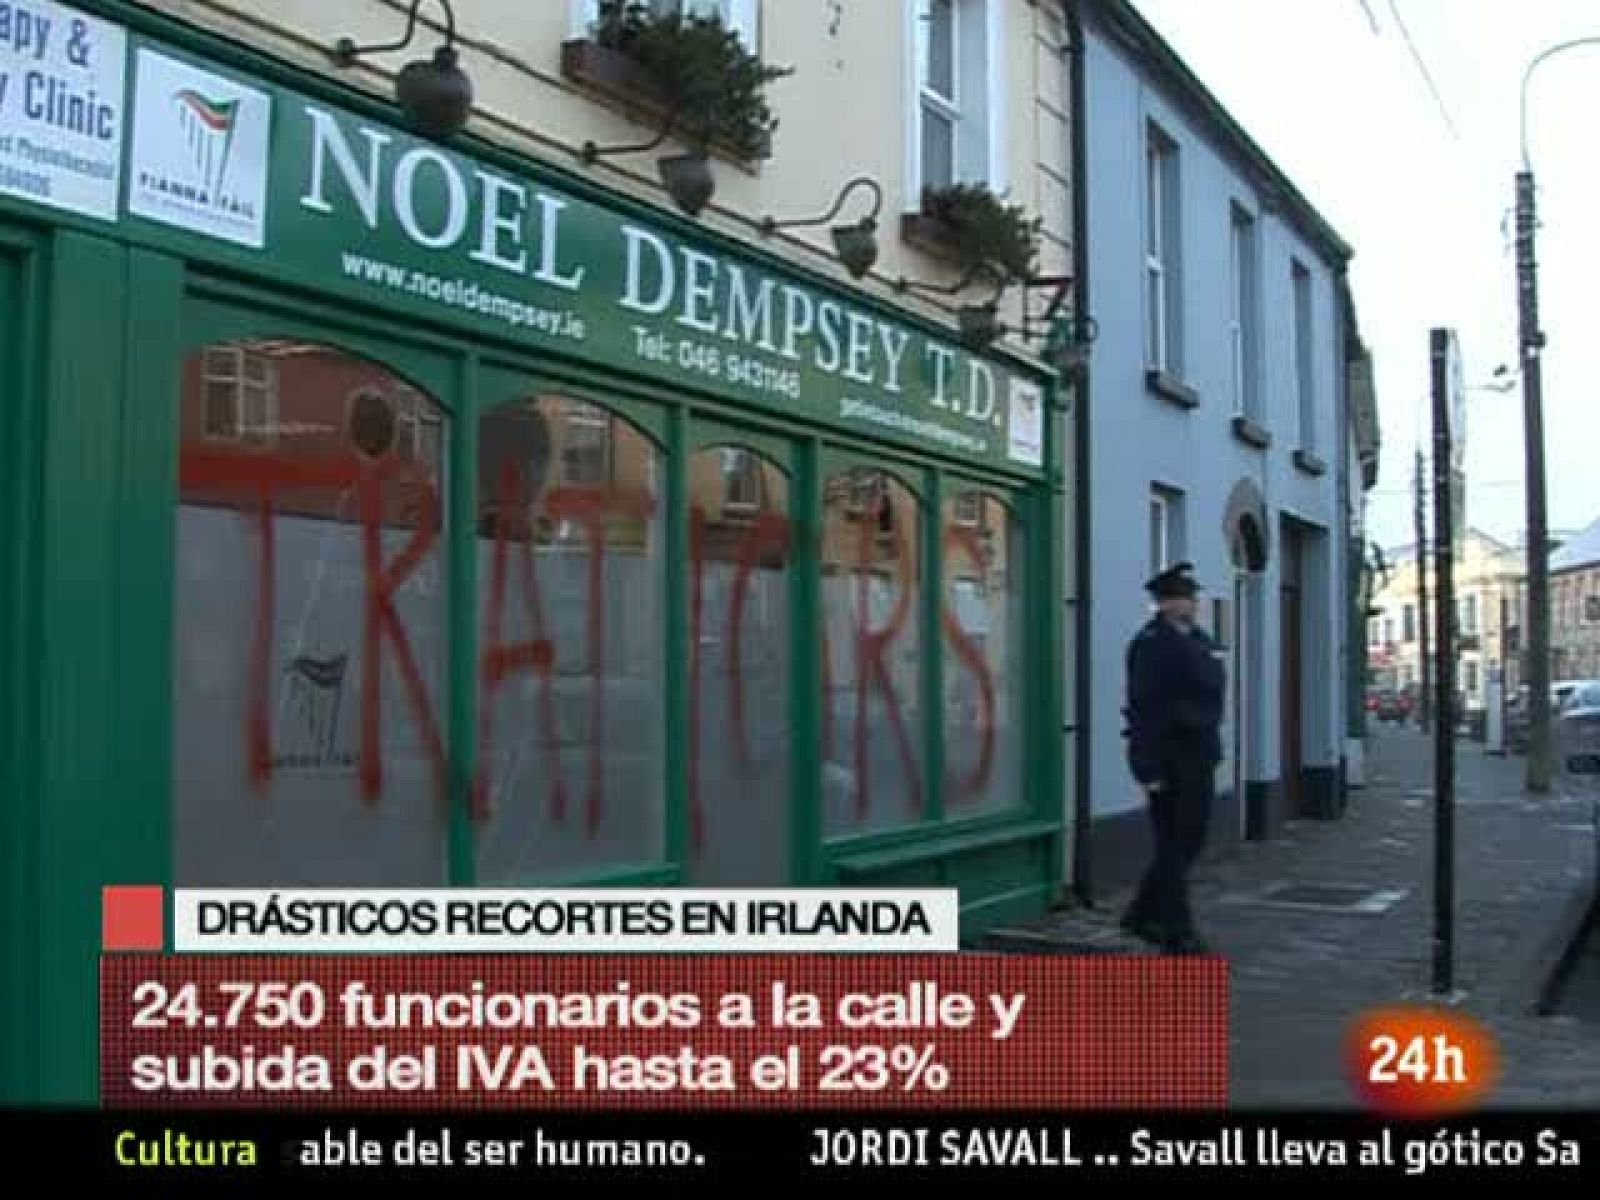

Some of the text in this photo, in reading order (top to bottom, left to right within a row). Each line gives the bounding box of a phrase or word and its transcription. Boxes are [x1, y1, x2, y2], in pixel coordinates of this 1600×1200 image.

[67, 17, 91, 67] &
[24, 69, 114, 140] Clinic
[300, 106, 1002, 427] NOEL DEMPSEY T.D.
[342, 252, 586, 340] www.noeldempsey.ie
